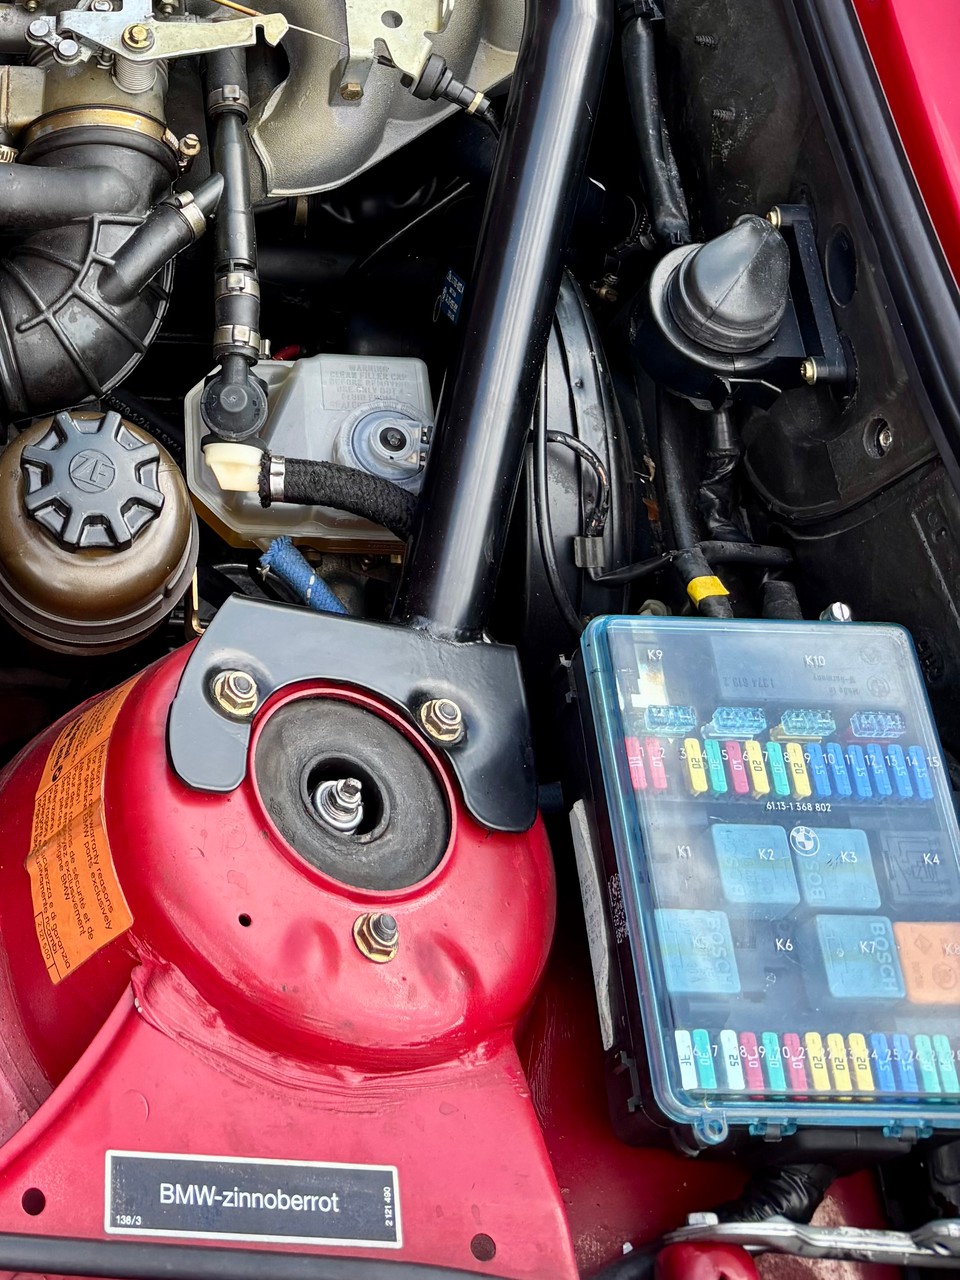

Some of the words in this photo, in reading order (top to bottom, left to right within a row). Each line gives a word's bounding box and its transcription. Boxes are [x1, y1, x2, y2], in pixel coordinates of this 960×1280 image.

[648, 650, 663, 660] K9
[805, 655, 826, 666] K10
[641, 747, 646, 757] 1
[659, 748, 666, 758] 2
[680, 748, 687, 759] 3
[702, 749, 708, 759] 4
[722, 750, 729, 760] 5
[742, 750, 749, 761] 6
[763, 751, 769, 762] 7
[784, 753, 790, 763] 8
[804, 753, 811, 763] 9
[823, 754, 836, 764] 10
[845, 754, 854, 765] 11
[865, 755, 876, 765] 12
[886, 755, 898, 766] 13
[906, 756, 918, 767] 14
[927, 757, 940, 767] 15
[732, 759, 743, 771] 10
[753, 760, 763, 772] 20
[793, 762, 803, 774] 20
[766, 801, 794, 811] 61.13-1
[796, 802, 813, 812] 368
[815, 802, 832, 812] 802
[677, 845, 692, 858] K1
[758, 848, 775, 861] K2
[840, 851, 858, 863] K3
[923, 853, 940, 865] K4
[60, 875, 71, 902] BMW
[83, 842, 93, 869] parts
[90, 871, 113, 931] exclusively
[96, 868, 114, 913] reasons
[64, 860, 87, 937] exclusivement
[45, 915, 59, 955] ricambi
[51, 922, 71, 970] garanzia
[775, 938, 793, 951] K6
[859, 941, 876, 953] K7
[870, 922, 898, 992] BOSCH
[729, 1054, 739, 1067] 25
[813, 1056, 824, 1069] 20
[834, 1057, 845, 1070] 20
[857, 1056, 867, 1070] 20
[159, 1182, 340, 1213] BMW-zinnoberrot
[384, 1186, 392, 1204] 490
[384, 1205, 393, 1219] 121
